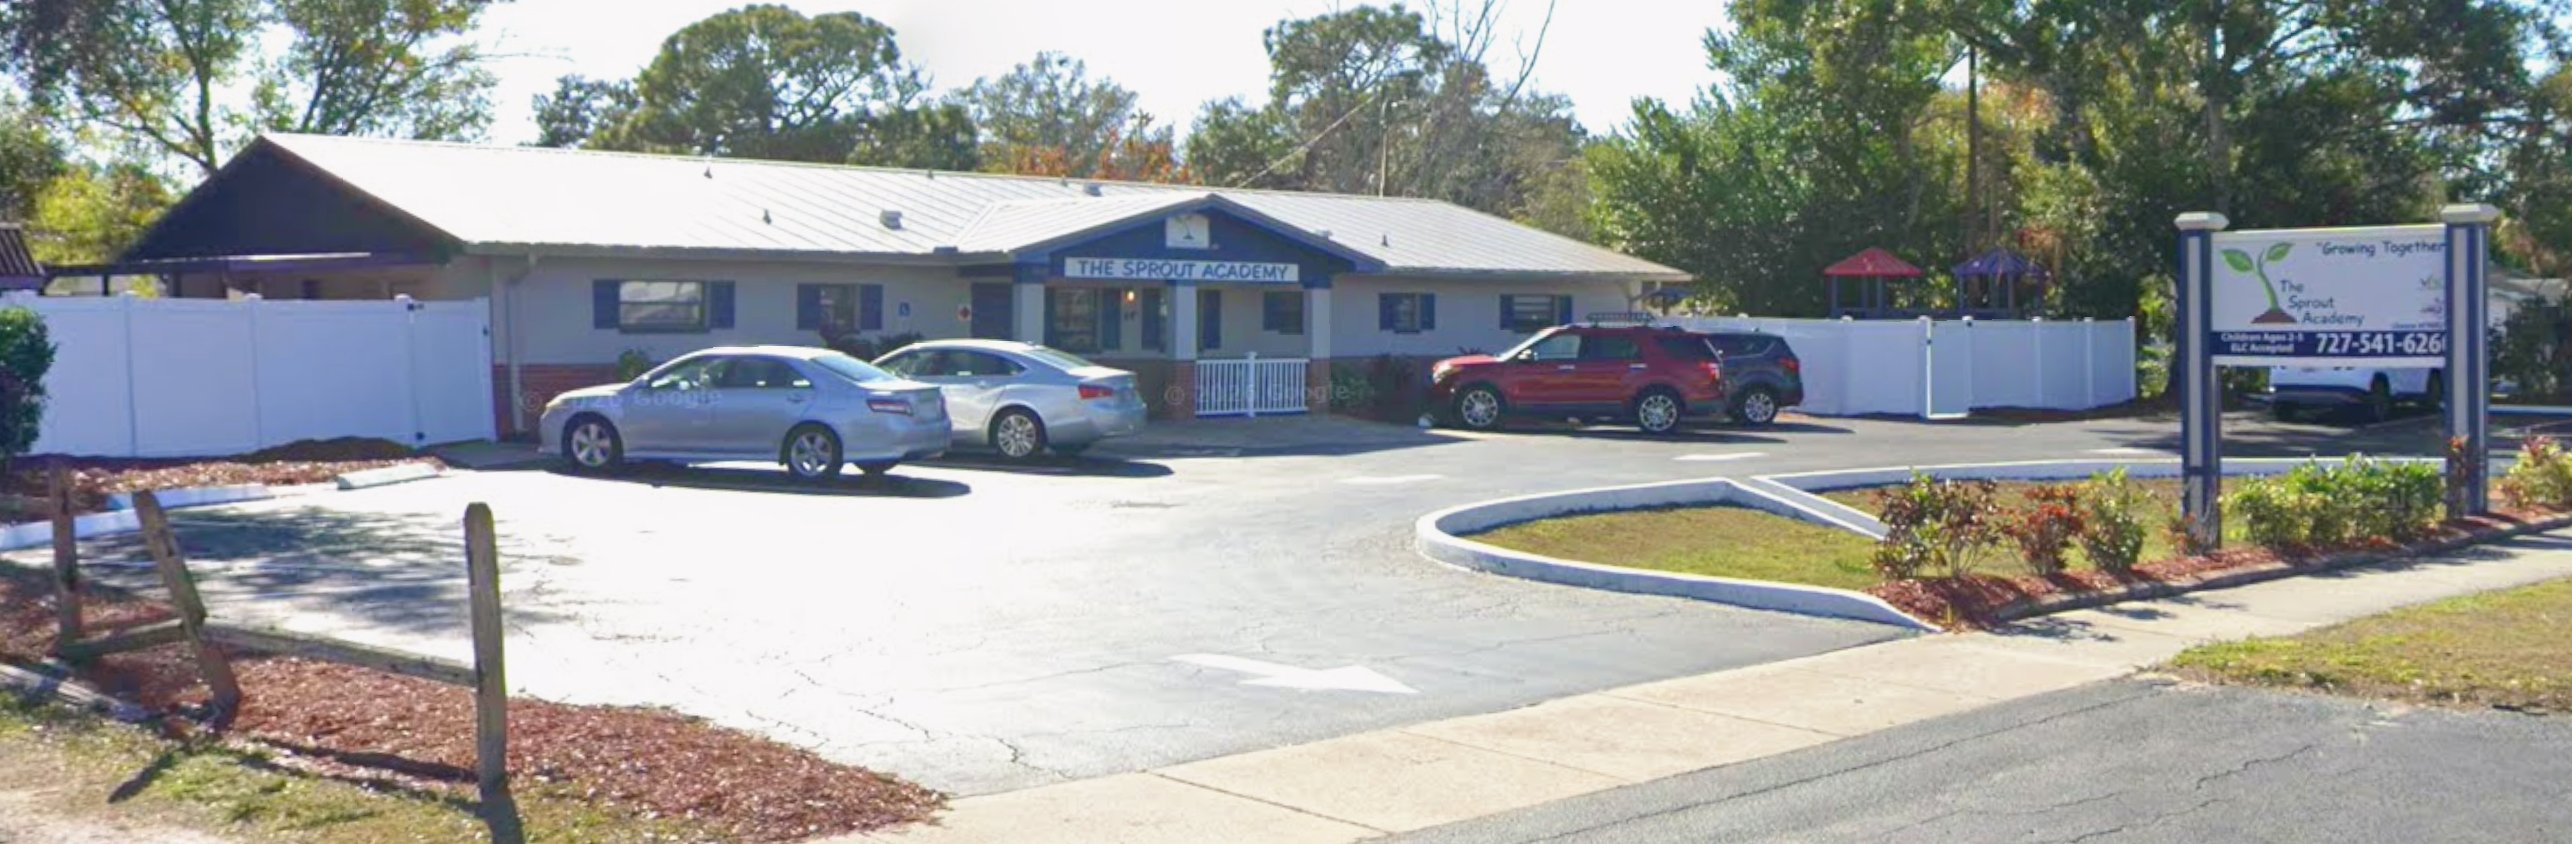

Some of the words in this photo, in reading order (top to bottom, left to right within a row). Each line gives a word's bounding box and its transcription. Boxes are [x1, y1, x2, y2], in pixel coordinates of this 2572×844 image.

[2382, 240, 2446, 257] Together
[1077, 260, 1115, 276] THE
[1122, 261, 1197, 278] SPROUT
[1201, 264, 1288, 281] ACADEMY
[2280, 279, 2304, 293] The
[2288, 295, 2334, 309] Sprout
[2301, 311, 2365, 327] Academy
[2221, 332, 2261, 342] Children
